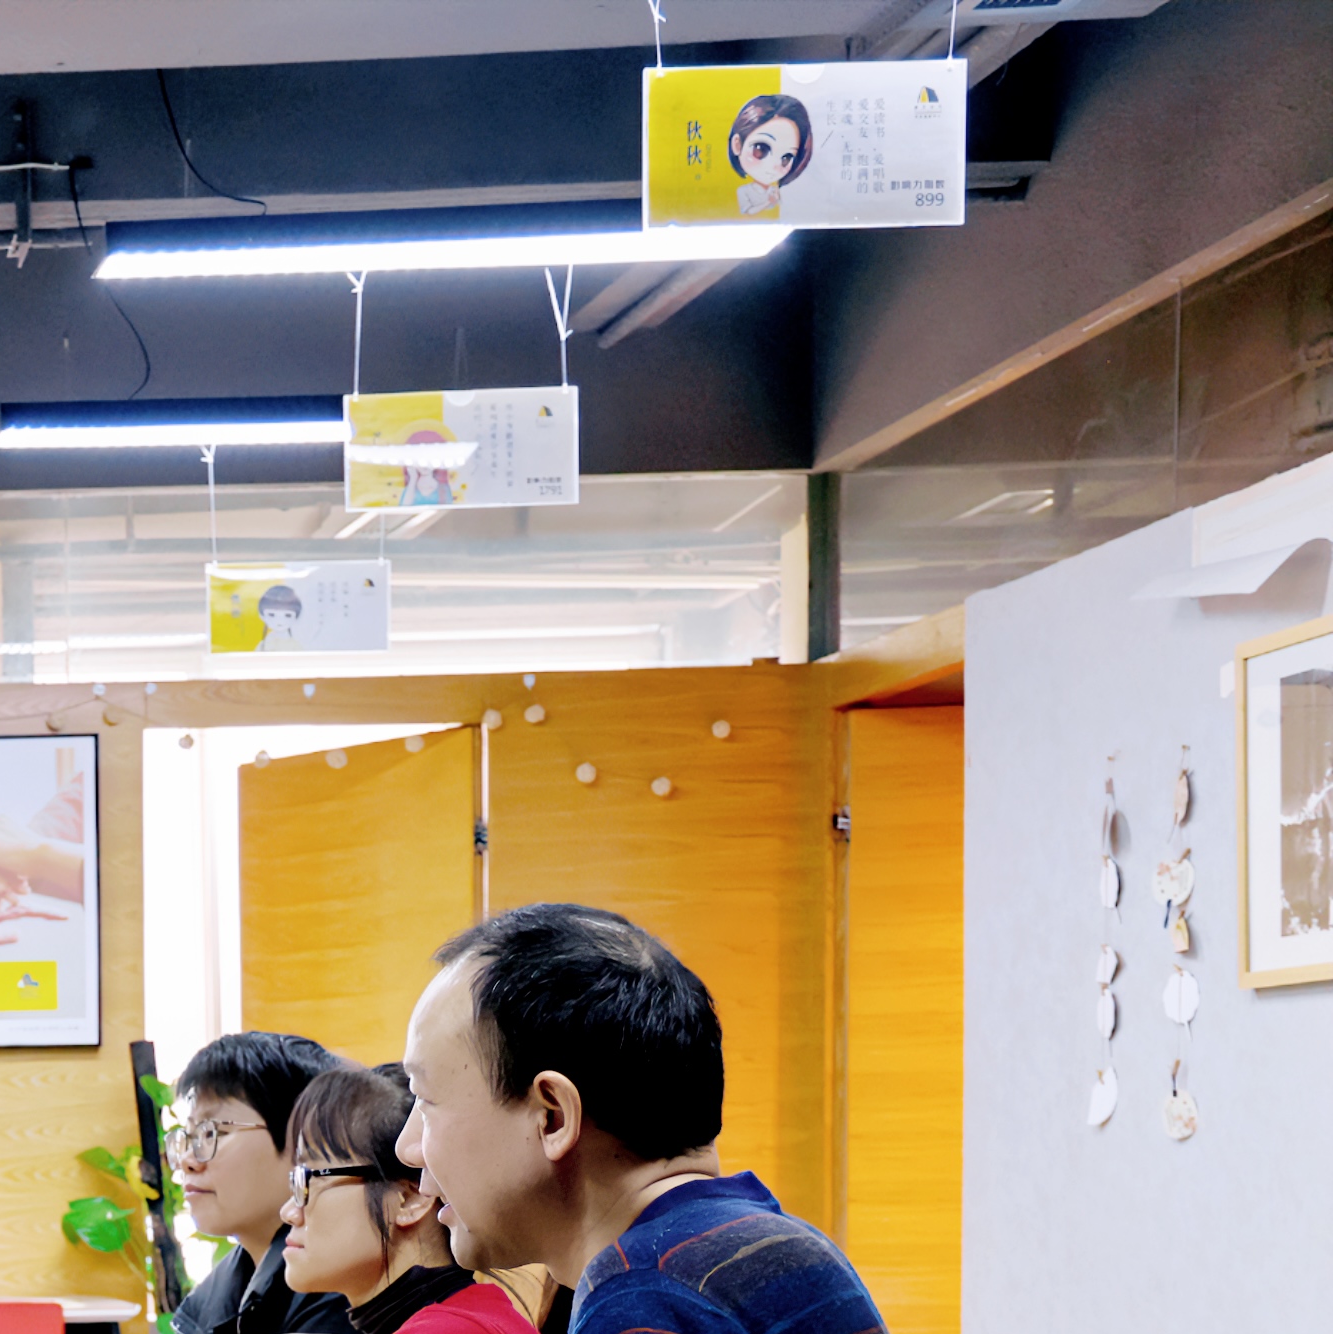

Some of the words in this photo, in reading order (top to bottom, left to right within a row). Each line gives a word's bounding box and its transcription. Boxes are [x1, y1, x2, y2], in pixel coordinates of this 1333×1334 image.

[687, 119, 703, 167] 秋秋
[915, 192, 945, 207] 899
[539, 485, 563, 496] 1791
